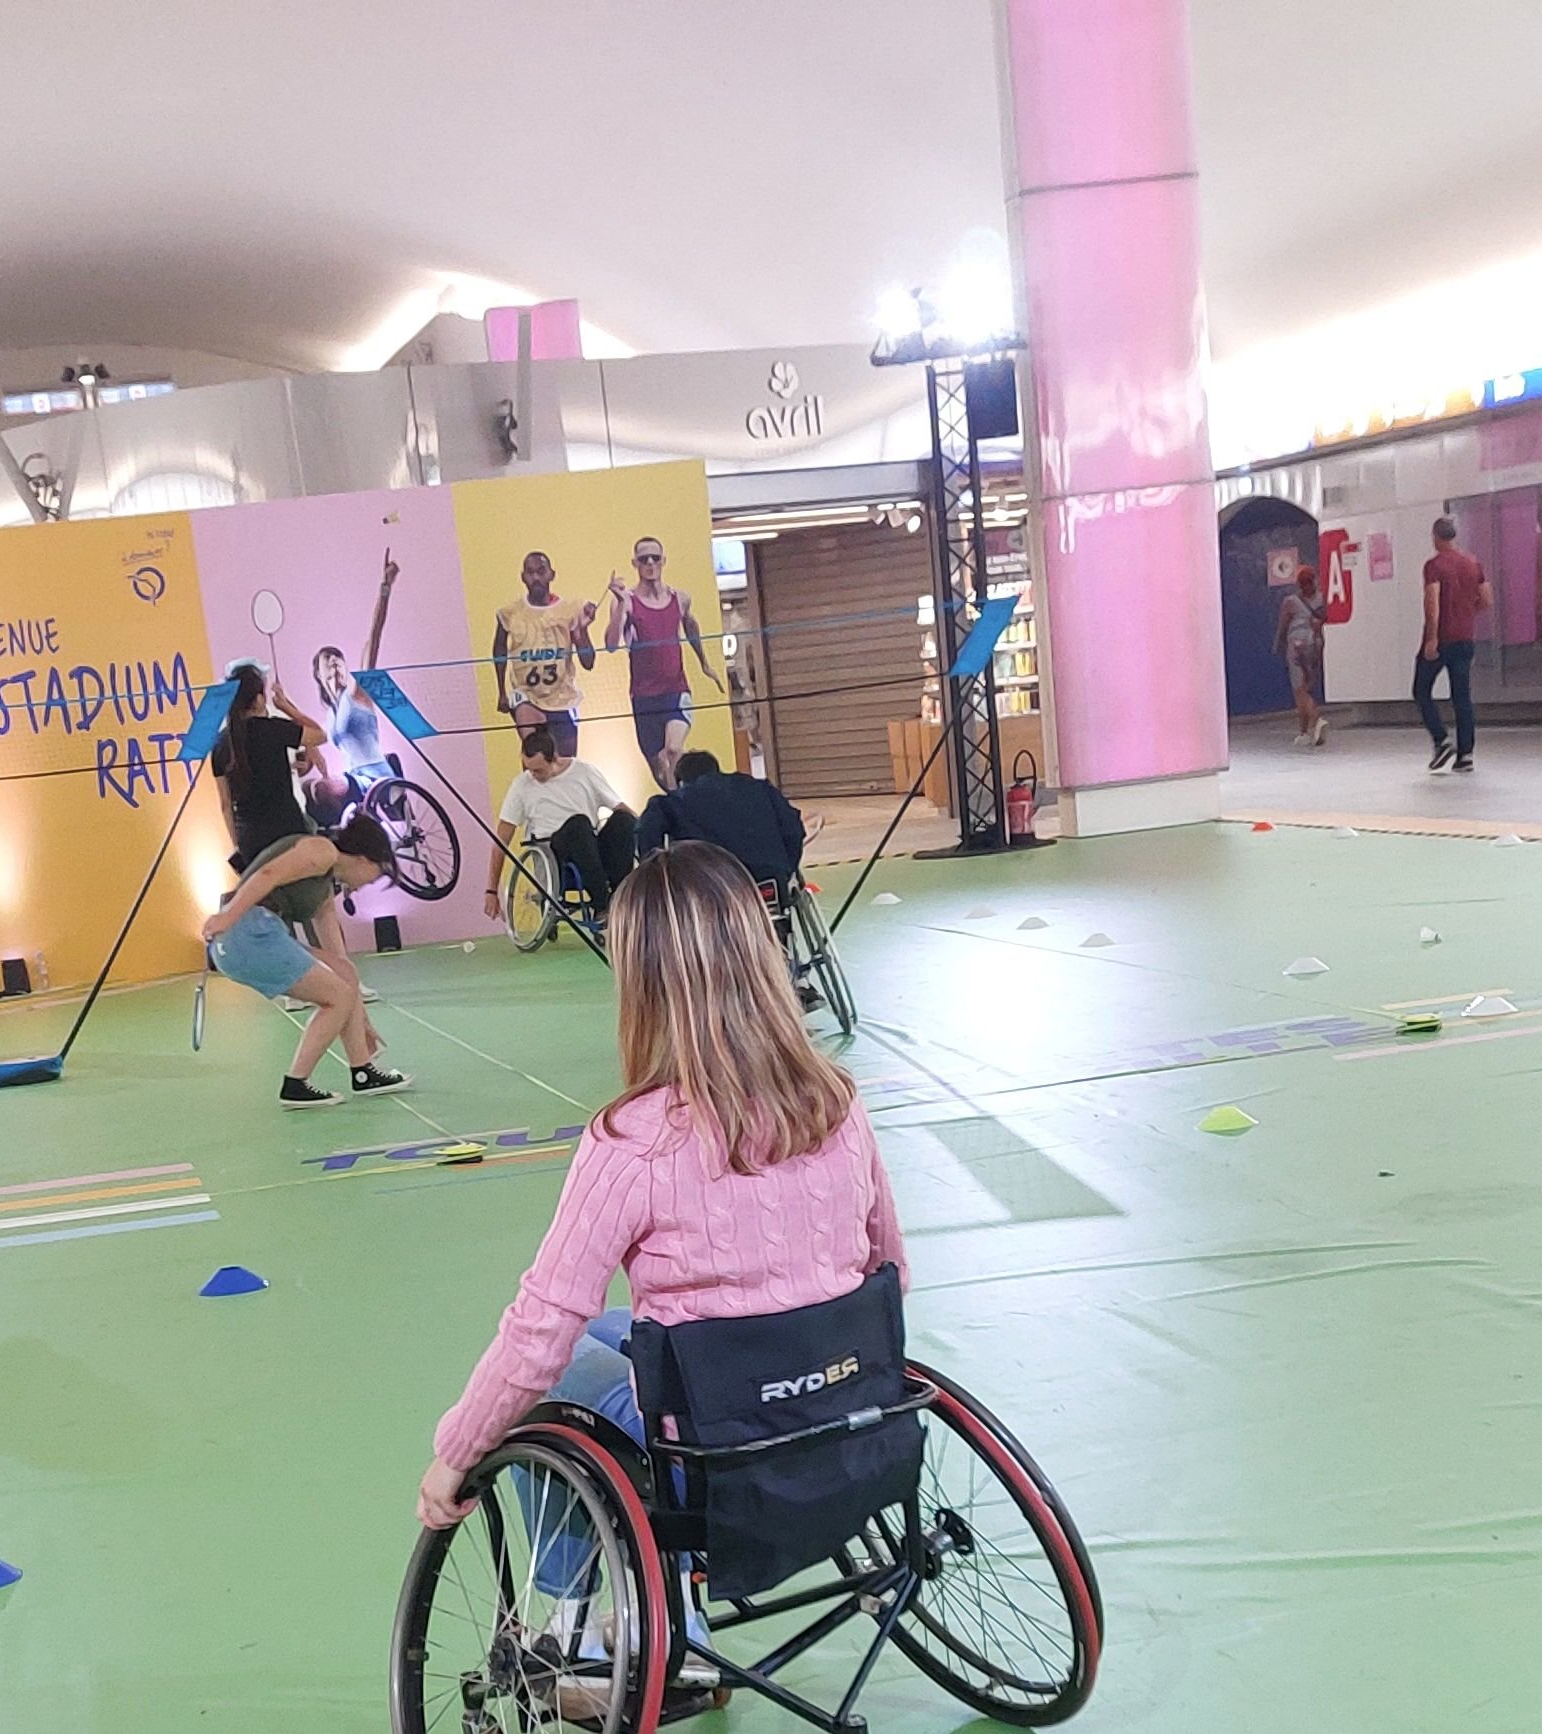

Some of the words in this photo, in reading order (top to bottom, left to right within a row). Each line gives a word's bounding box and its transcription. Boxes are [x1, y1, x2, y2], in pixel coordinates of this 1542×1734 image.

[745, 394, 825, 439] avril
[526, 663, 559, 688] 63
[760, 1356, 860, 1403] RYDER
